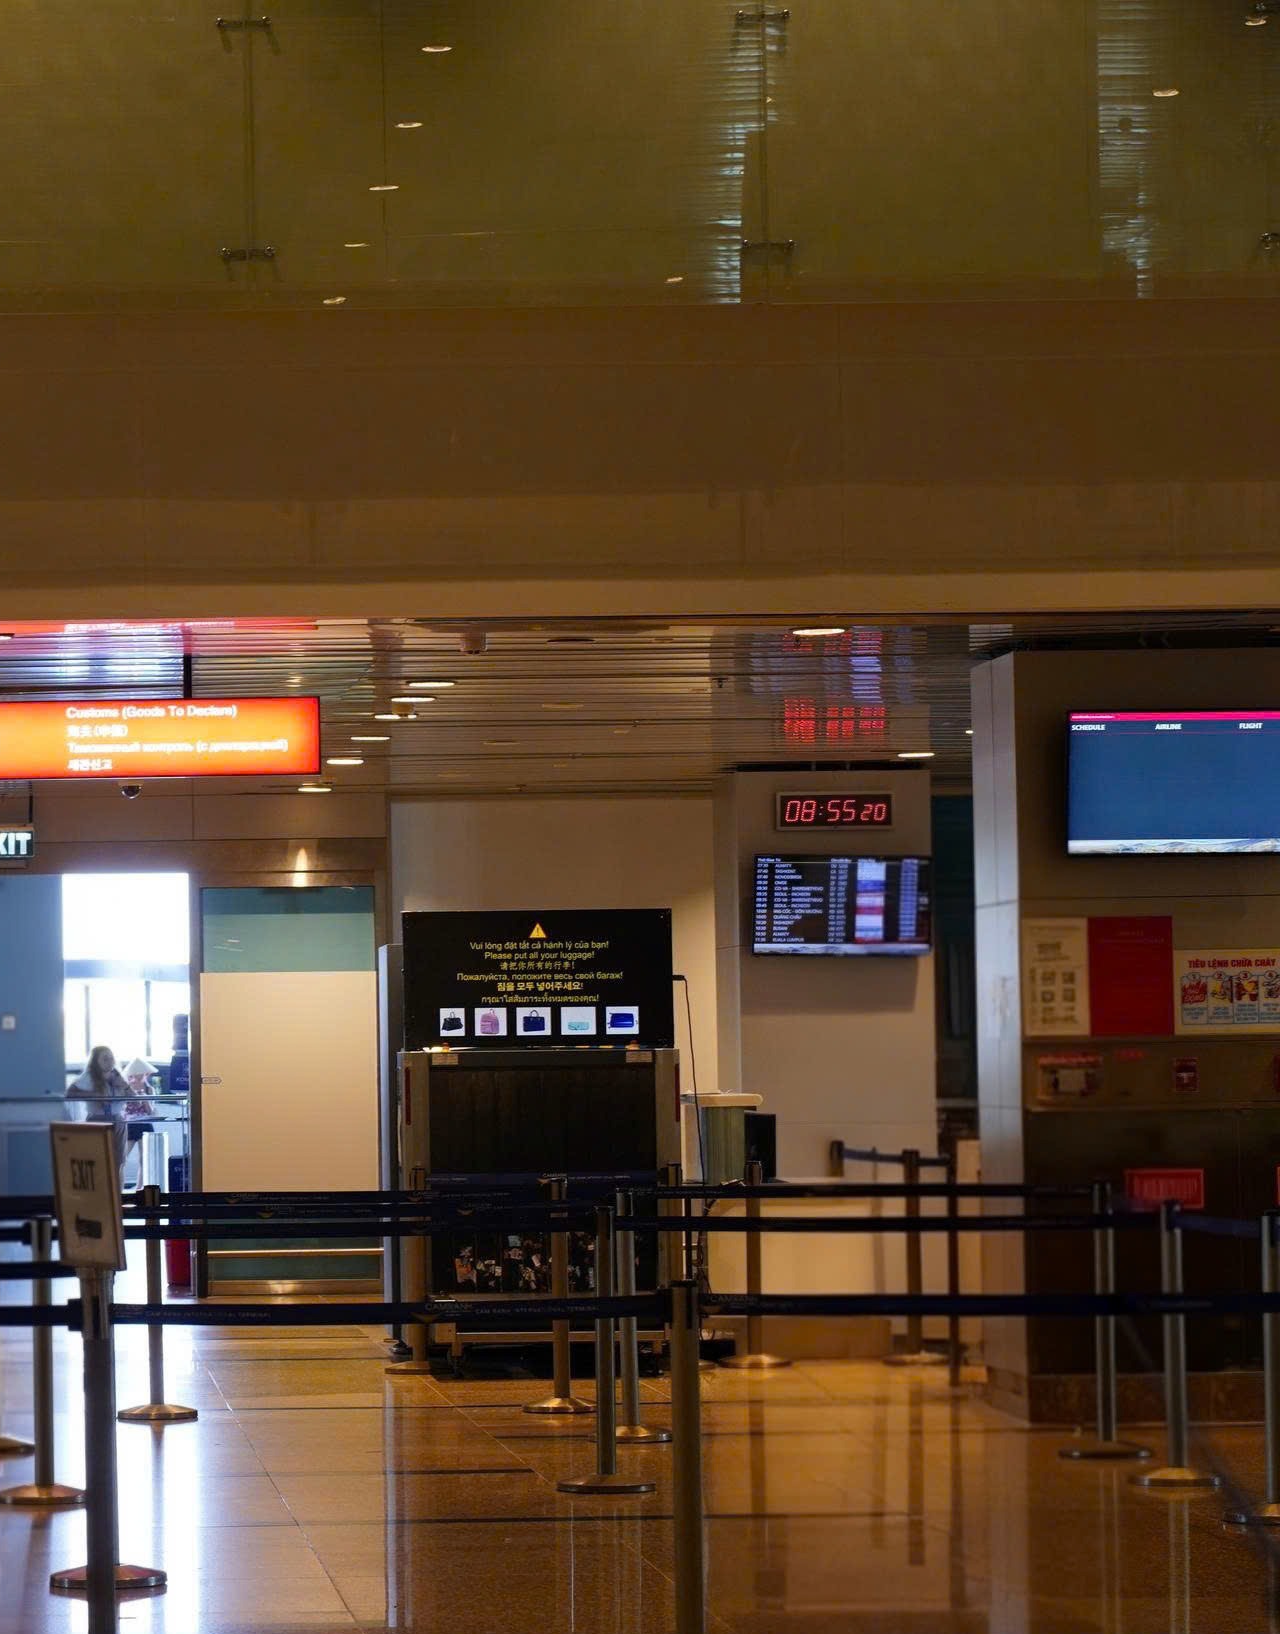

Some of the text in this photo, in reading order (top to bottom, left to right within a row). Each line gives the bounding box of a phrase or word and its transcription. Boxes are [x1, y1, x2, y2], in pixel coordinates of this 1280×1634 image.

[168, 705, 185, 716] To
[470, 942, 483, 950] Vui
[485, 942, 502, 951] lòng
[565, 941, 572, 950] lý
[484, 951, 595, 960] Please put all your luggage!
[575, 971, 595, 979] свой
[596, 971, 623, 979] багаж!
[516, 982, 535, 991] 모두
[71, 1158, 96, 1192] EXIT
